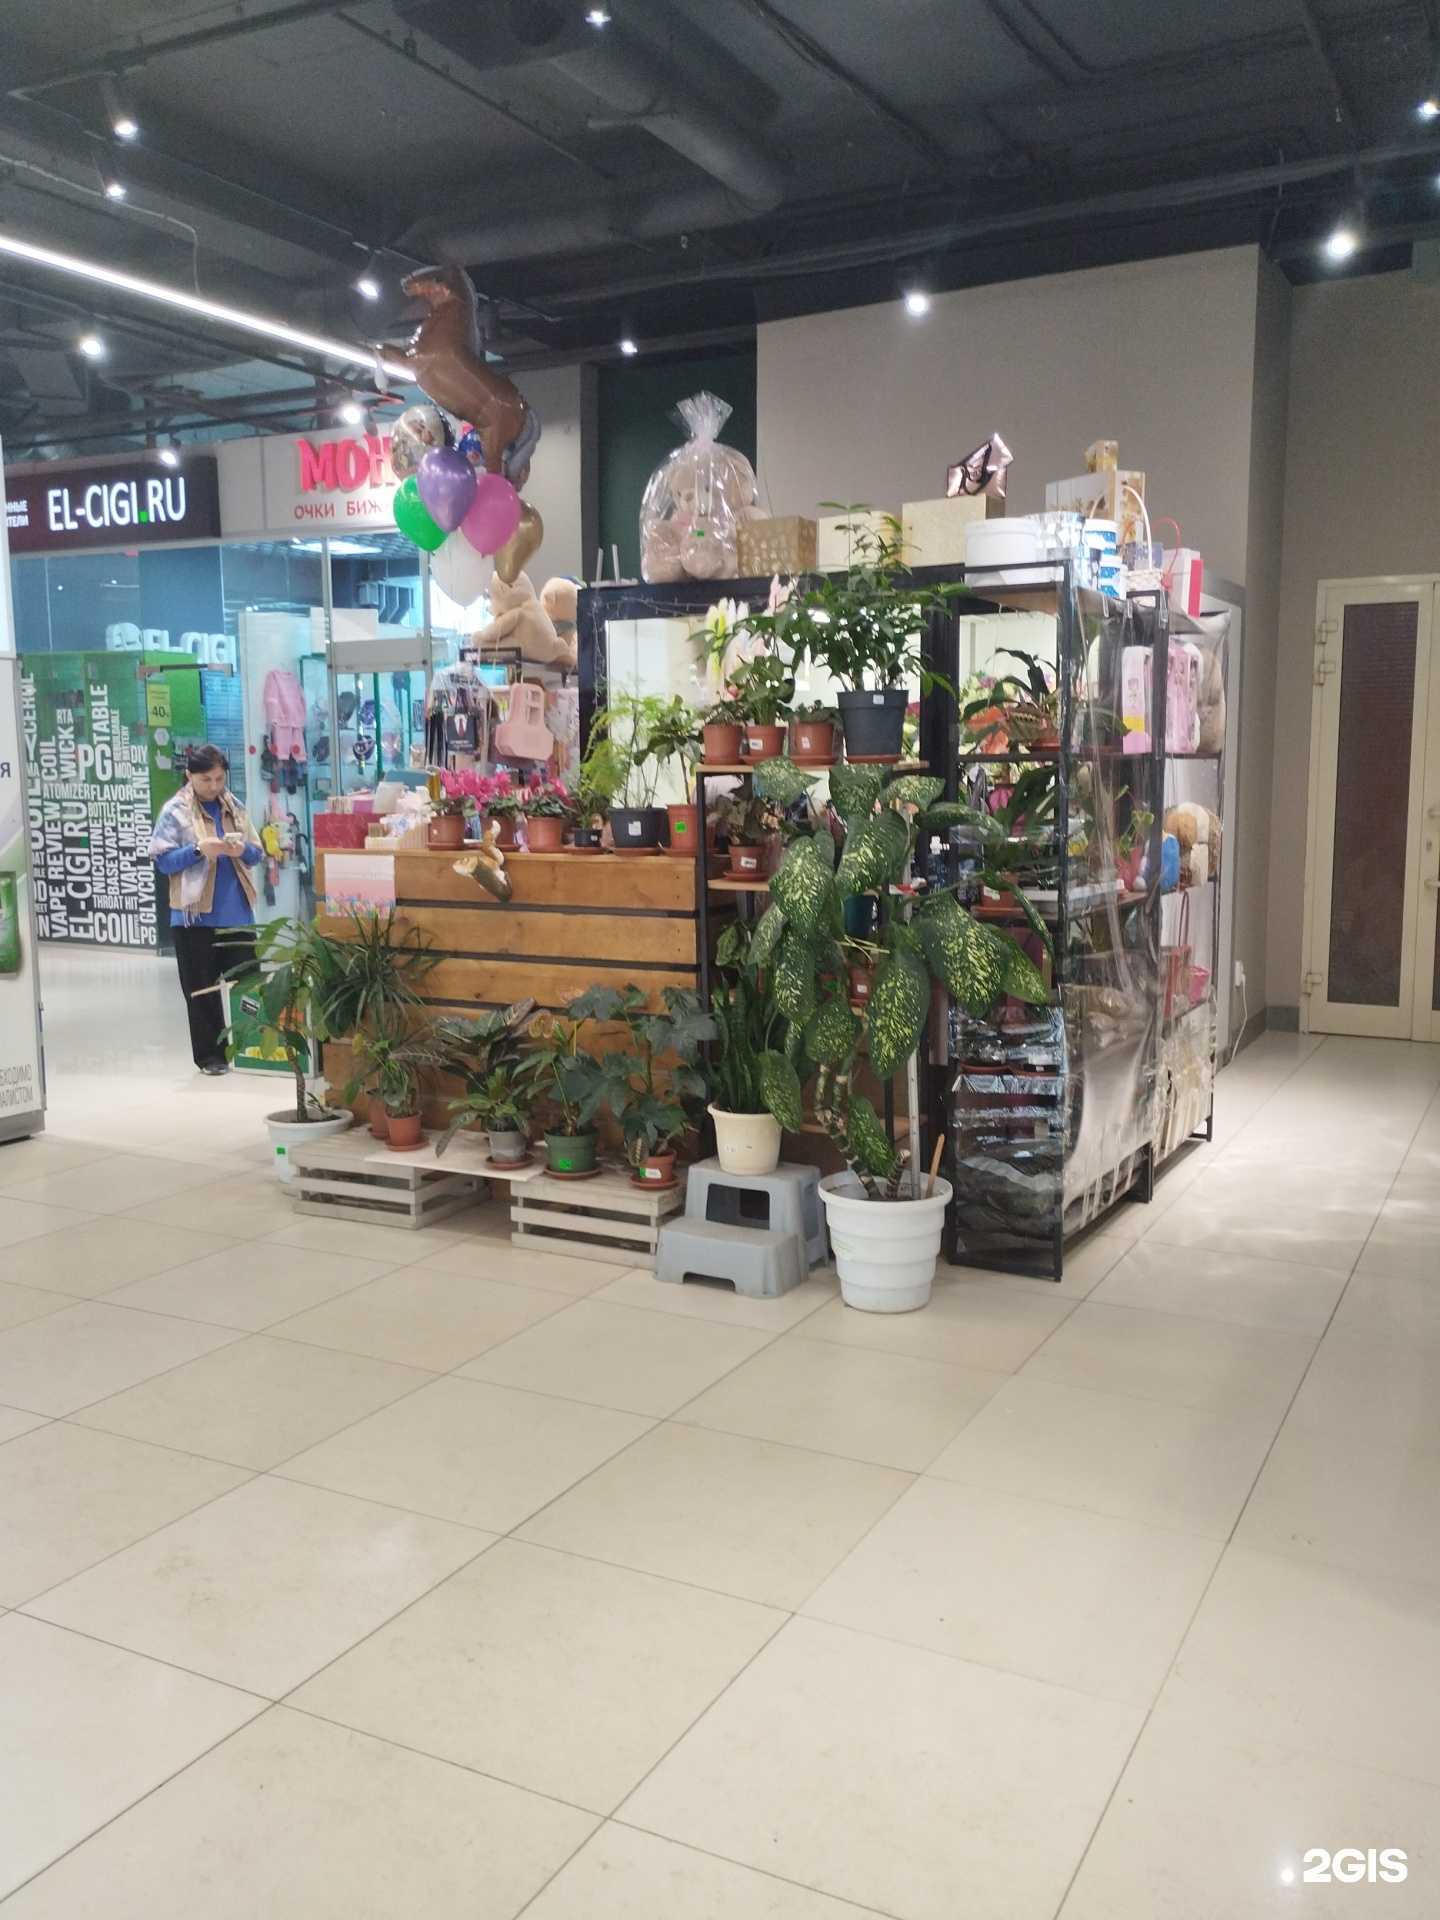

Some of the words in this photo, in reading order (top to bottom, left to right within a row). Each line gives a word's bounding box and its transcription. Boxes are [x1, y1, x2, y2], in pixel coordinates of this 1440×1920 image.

[48, 477, 186, 531] EL-CIGI.RU
[294, 504, 335, 519] ОЧКИ
[40, 735, 58, 781] COIL
[58, 726, 77, 780] WICK
[130, 745, 148, 763] DIY
[42, 783, 91, 800] ATOMIZER
[91, 783, 133, 801] FLAVOR
[43, 801, 65, 880] REVIEW
[117, 803, 135, 847] MEET
[62, 801, 94, 939] EL-CIGI.RU
[90, 819, 106, 894] NICOTINE
[119, 850, 138, 894] VAPE
[50, 886, 69, 938] VAPE
[92, 894, 123, 910] THROAT
[124, 896, 139, 911] HIT
[137, 861, 157, 924] GLYCOL
[93, 912, 140, 945] COIL
[140, 926, 157, 945] PG
